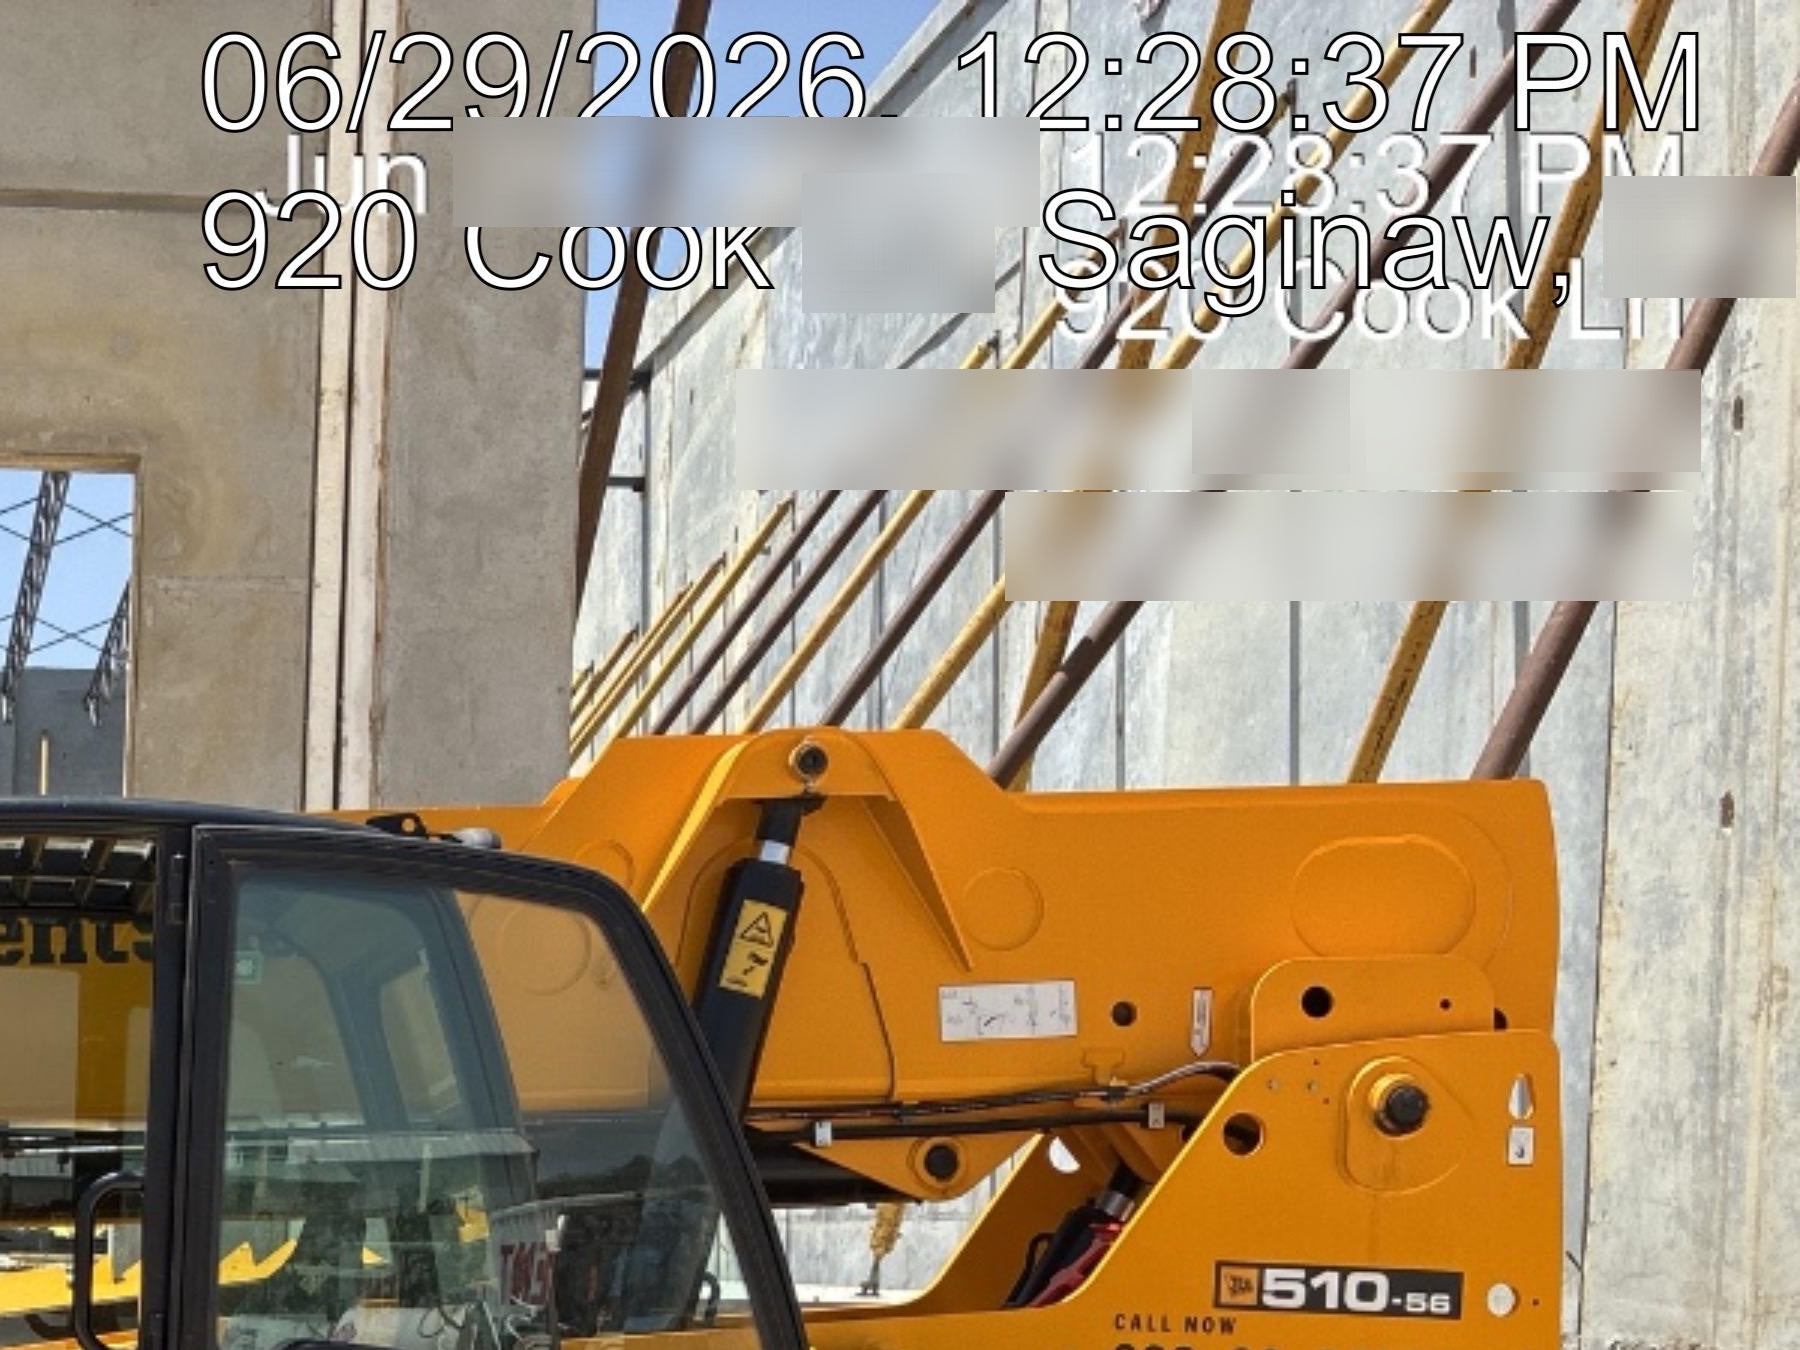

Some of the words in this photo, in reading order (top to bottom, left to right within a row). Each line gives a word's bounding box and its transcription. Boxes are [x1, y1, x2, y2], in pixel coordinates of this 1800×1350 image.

[1261, 1268, 1452, 1315] 510-56
[1114, 1313, 1171, 1333] CALL
[1184, 1316, 1236, 1335] NOW
